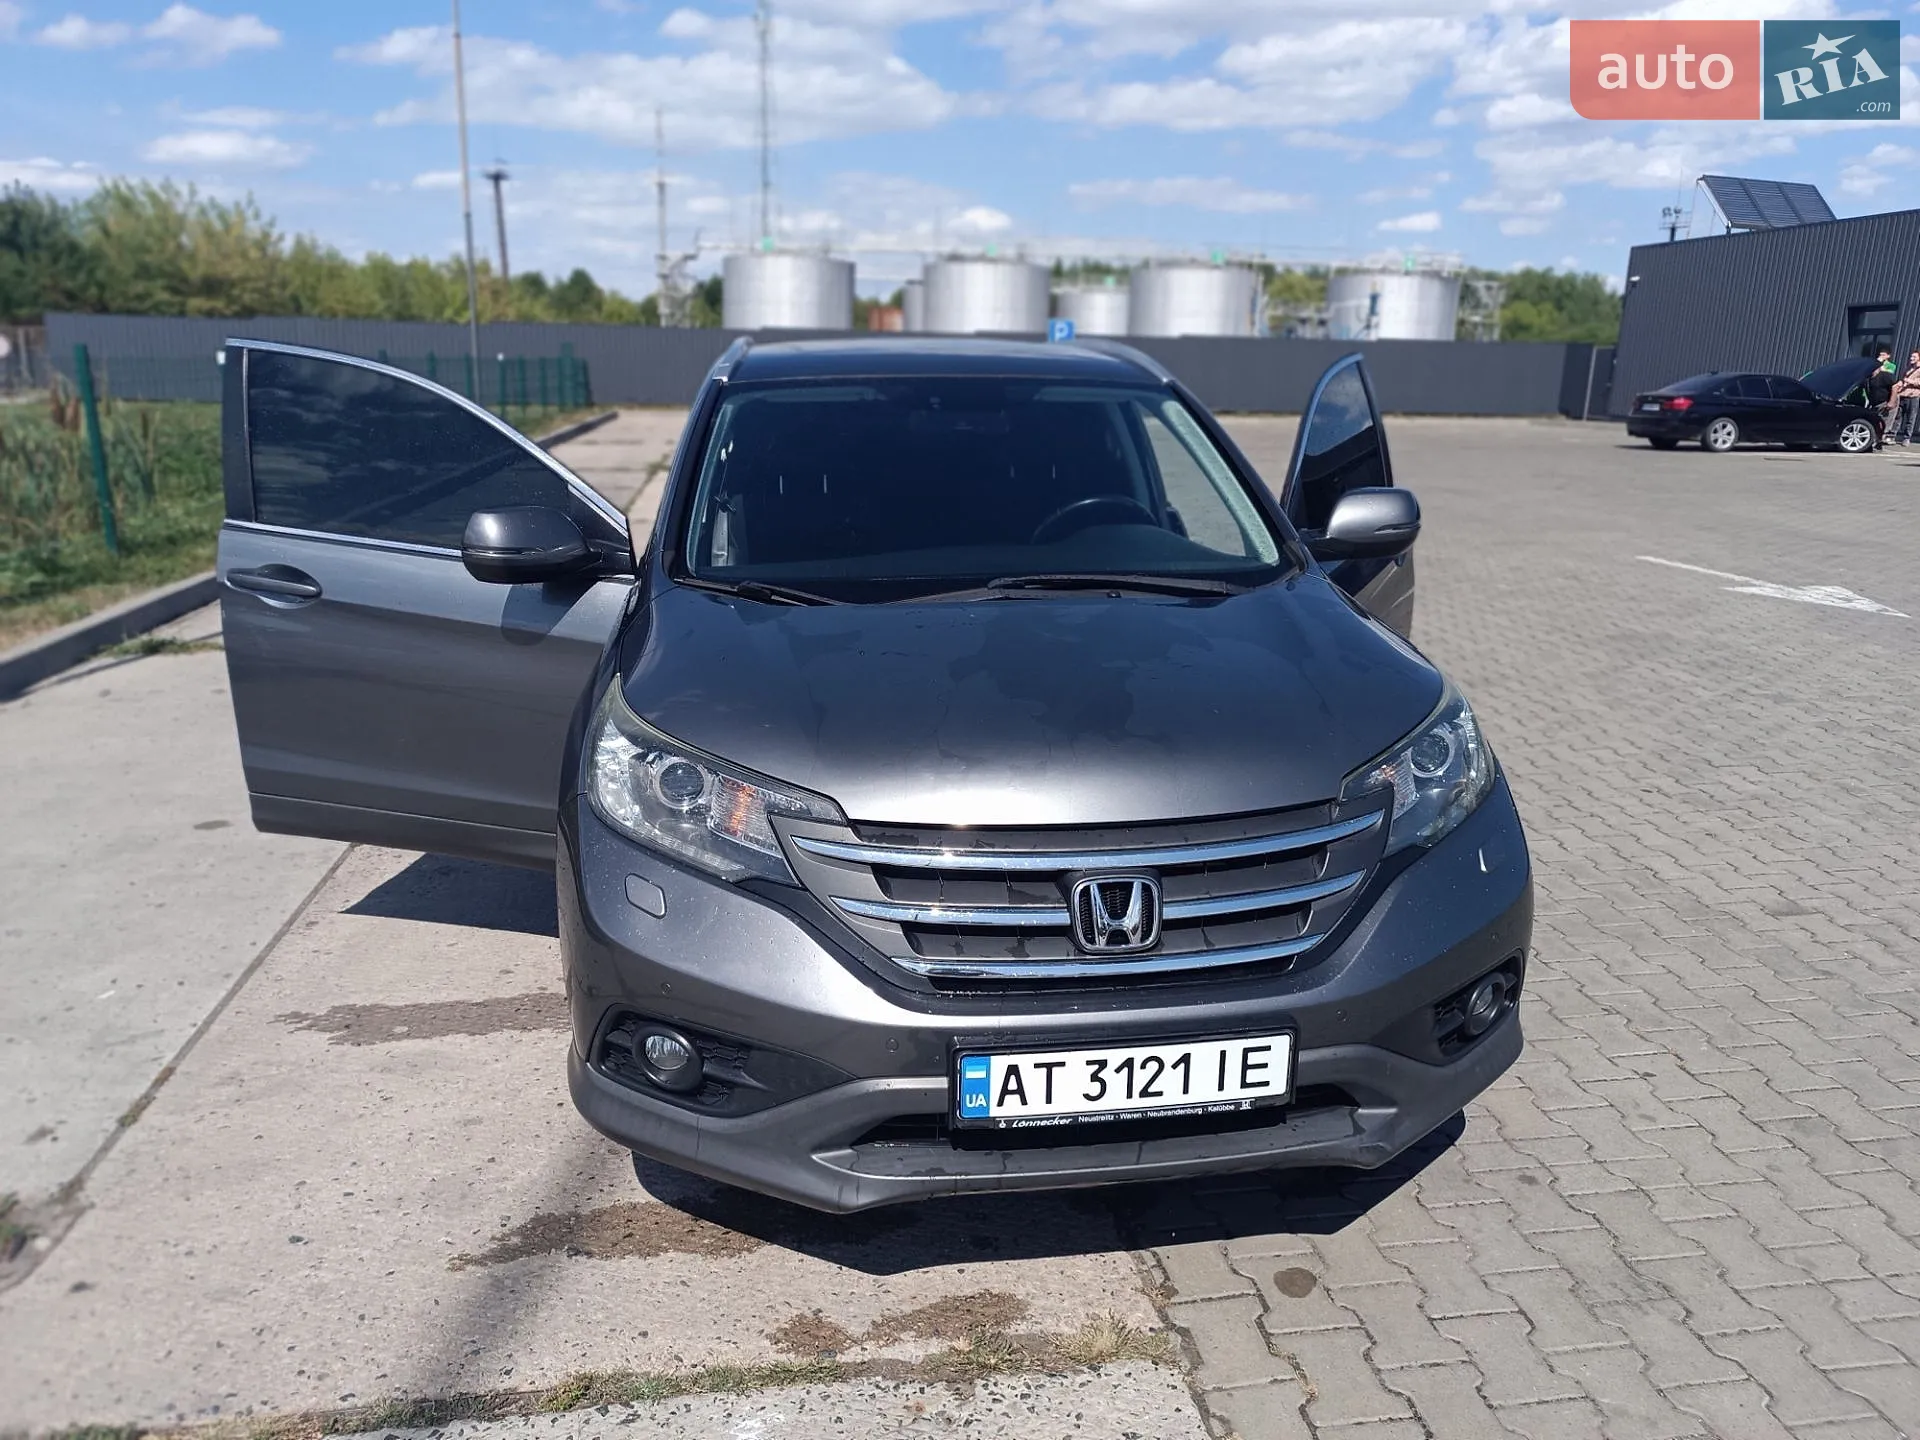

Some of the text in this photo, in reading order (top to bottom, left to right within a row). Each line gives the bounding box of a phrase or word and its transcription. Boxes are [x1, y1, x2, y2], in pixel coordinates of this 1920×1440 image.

[1054, 322, 1069, 342] P
[996, 1045, 1272, 1107] AT 3121 IE
[965, 1093, 987, 1108] UA
